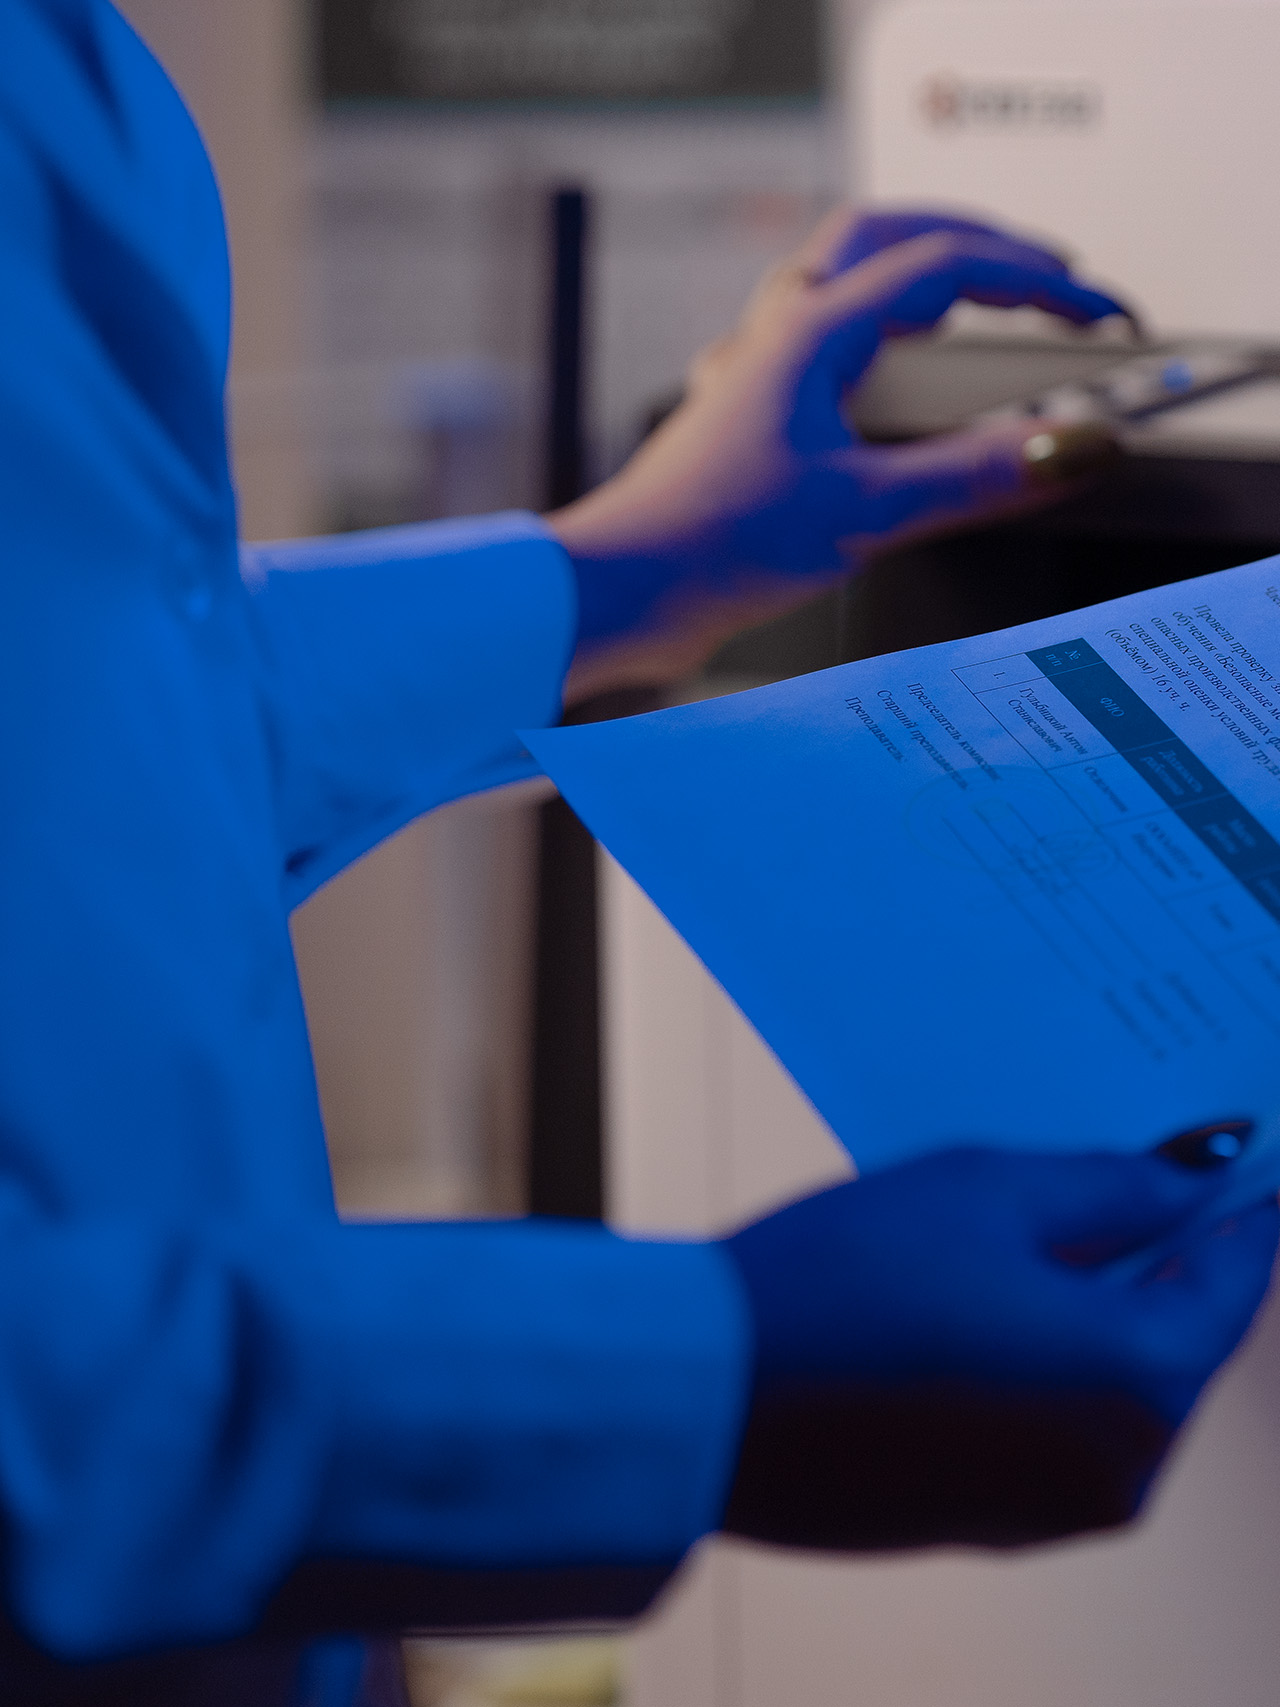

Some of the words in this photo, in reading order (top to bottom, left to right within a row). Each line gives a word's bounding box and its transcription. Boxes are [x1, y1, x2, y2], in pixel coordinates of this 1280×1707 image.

[1191, 603, 1236, 642] Провела
[1226, 641, 1274, 684] проверку
[1125, 622, 1191, 679] специальной
[1181, 678, 1221, 712] оценки
[1210, 710, 1260, 749] условий
[1147, 616, 1192, 655] опасных
[1183, 654, 1273, 737] производственных
[1148, 673, 1174, 687] 16
[1209, 651, 1274, 708] «Безопасные
[874, 688, 919, 730] Старший
[905, 682, 965, 740] Председатель
[1094, 695, 1128, 718] ФИО
